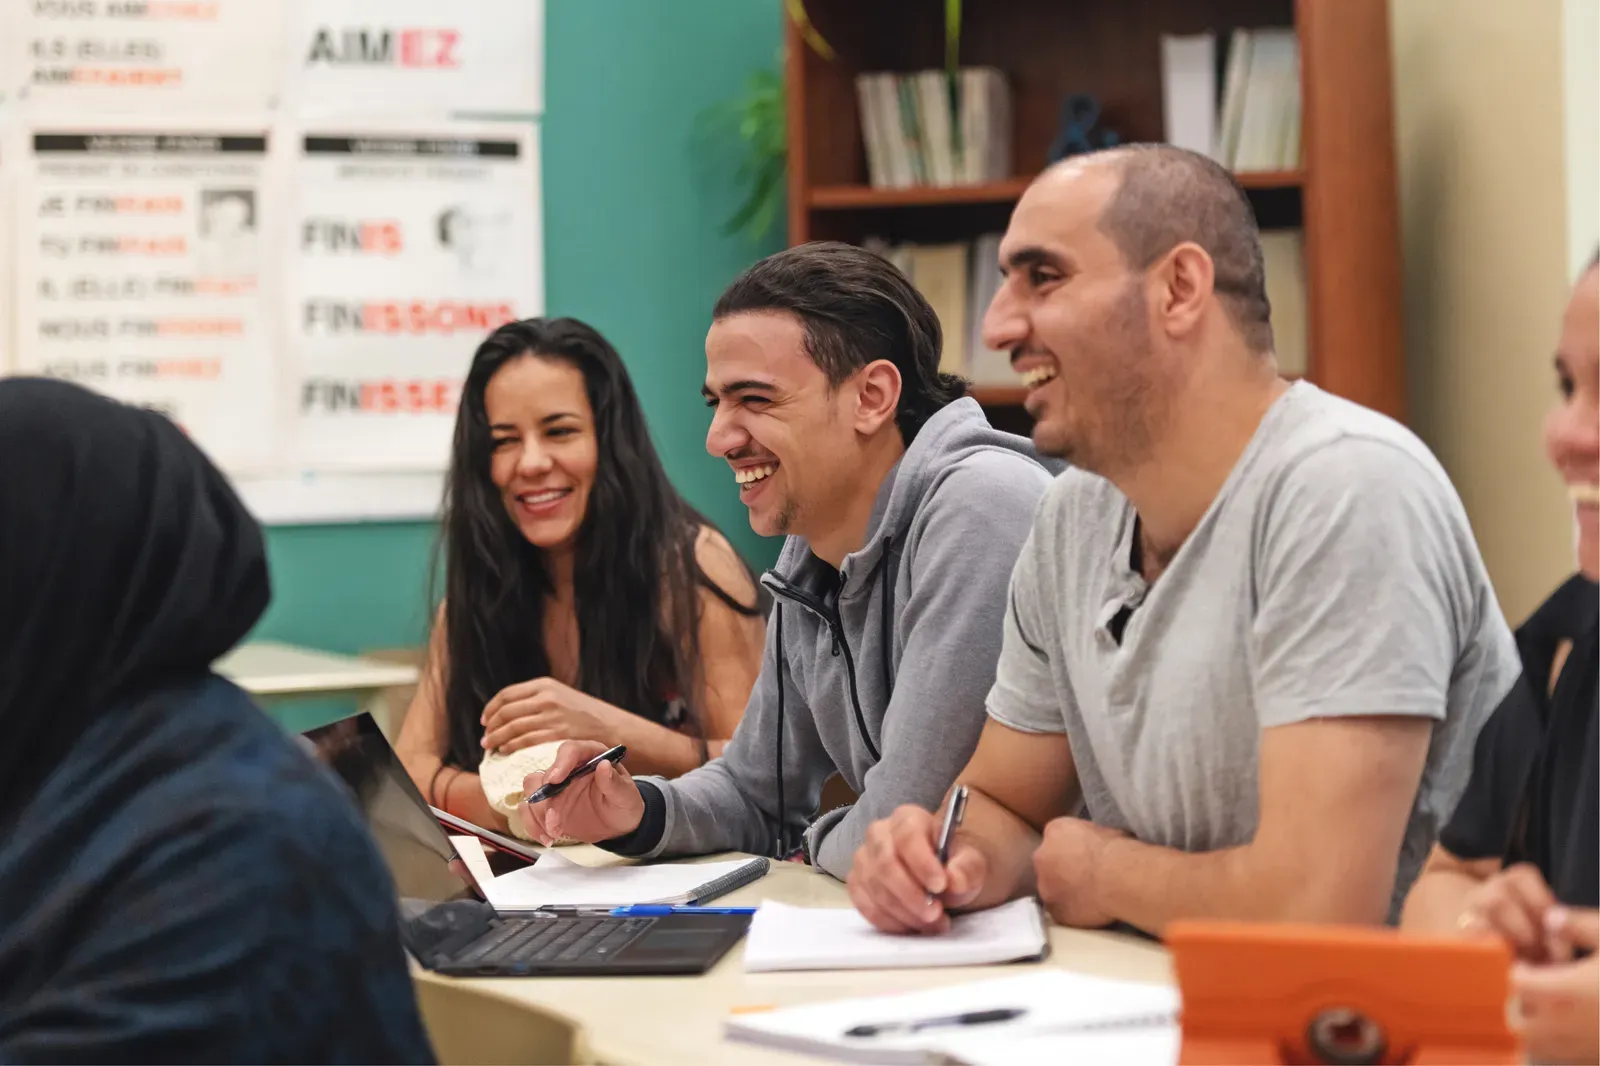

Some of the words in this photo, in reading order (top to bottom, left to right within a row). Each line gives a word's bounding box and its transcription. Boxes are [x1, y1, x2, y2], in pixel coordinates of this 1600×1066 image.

[306, 28, 459, 68] AIMEZ
[302, 218, 403, 256] FINIS
[303, 300, 513, 334] FINISSONS
